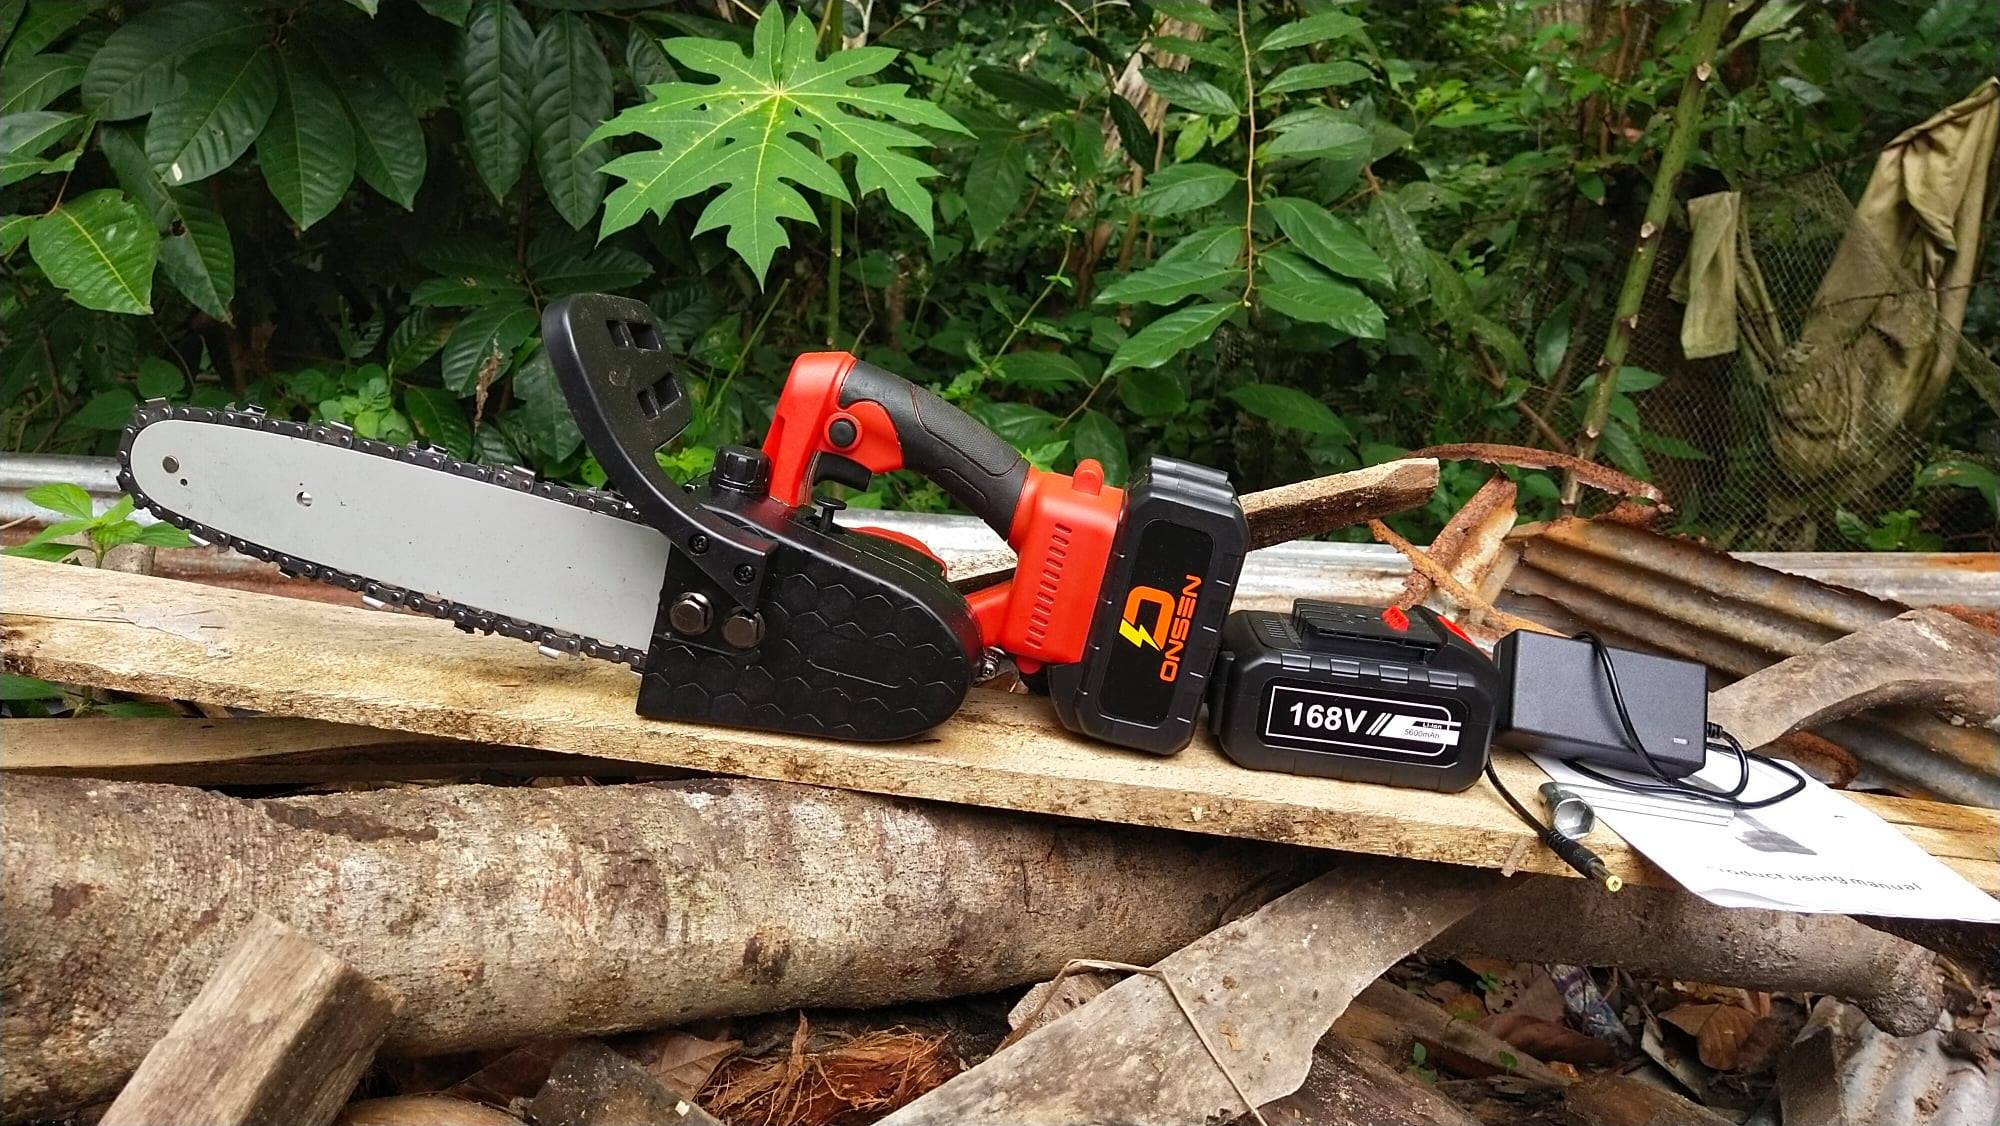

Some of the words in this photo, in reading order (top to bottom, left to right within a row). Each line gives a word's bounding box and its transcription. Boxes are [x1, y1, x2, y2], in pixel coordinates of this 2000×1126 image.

[1159, 574, 1202, 682] ONSEN
[1290, 701, 1368, 733] 168V
[1706, 865, 1787, 880] roduct
[1788, 874, 1848, 885] using
[1849, 878, 1923, 891] manual
